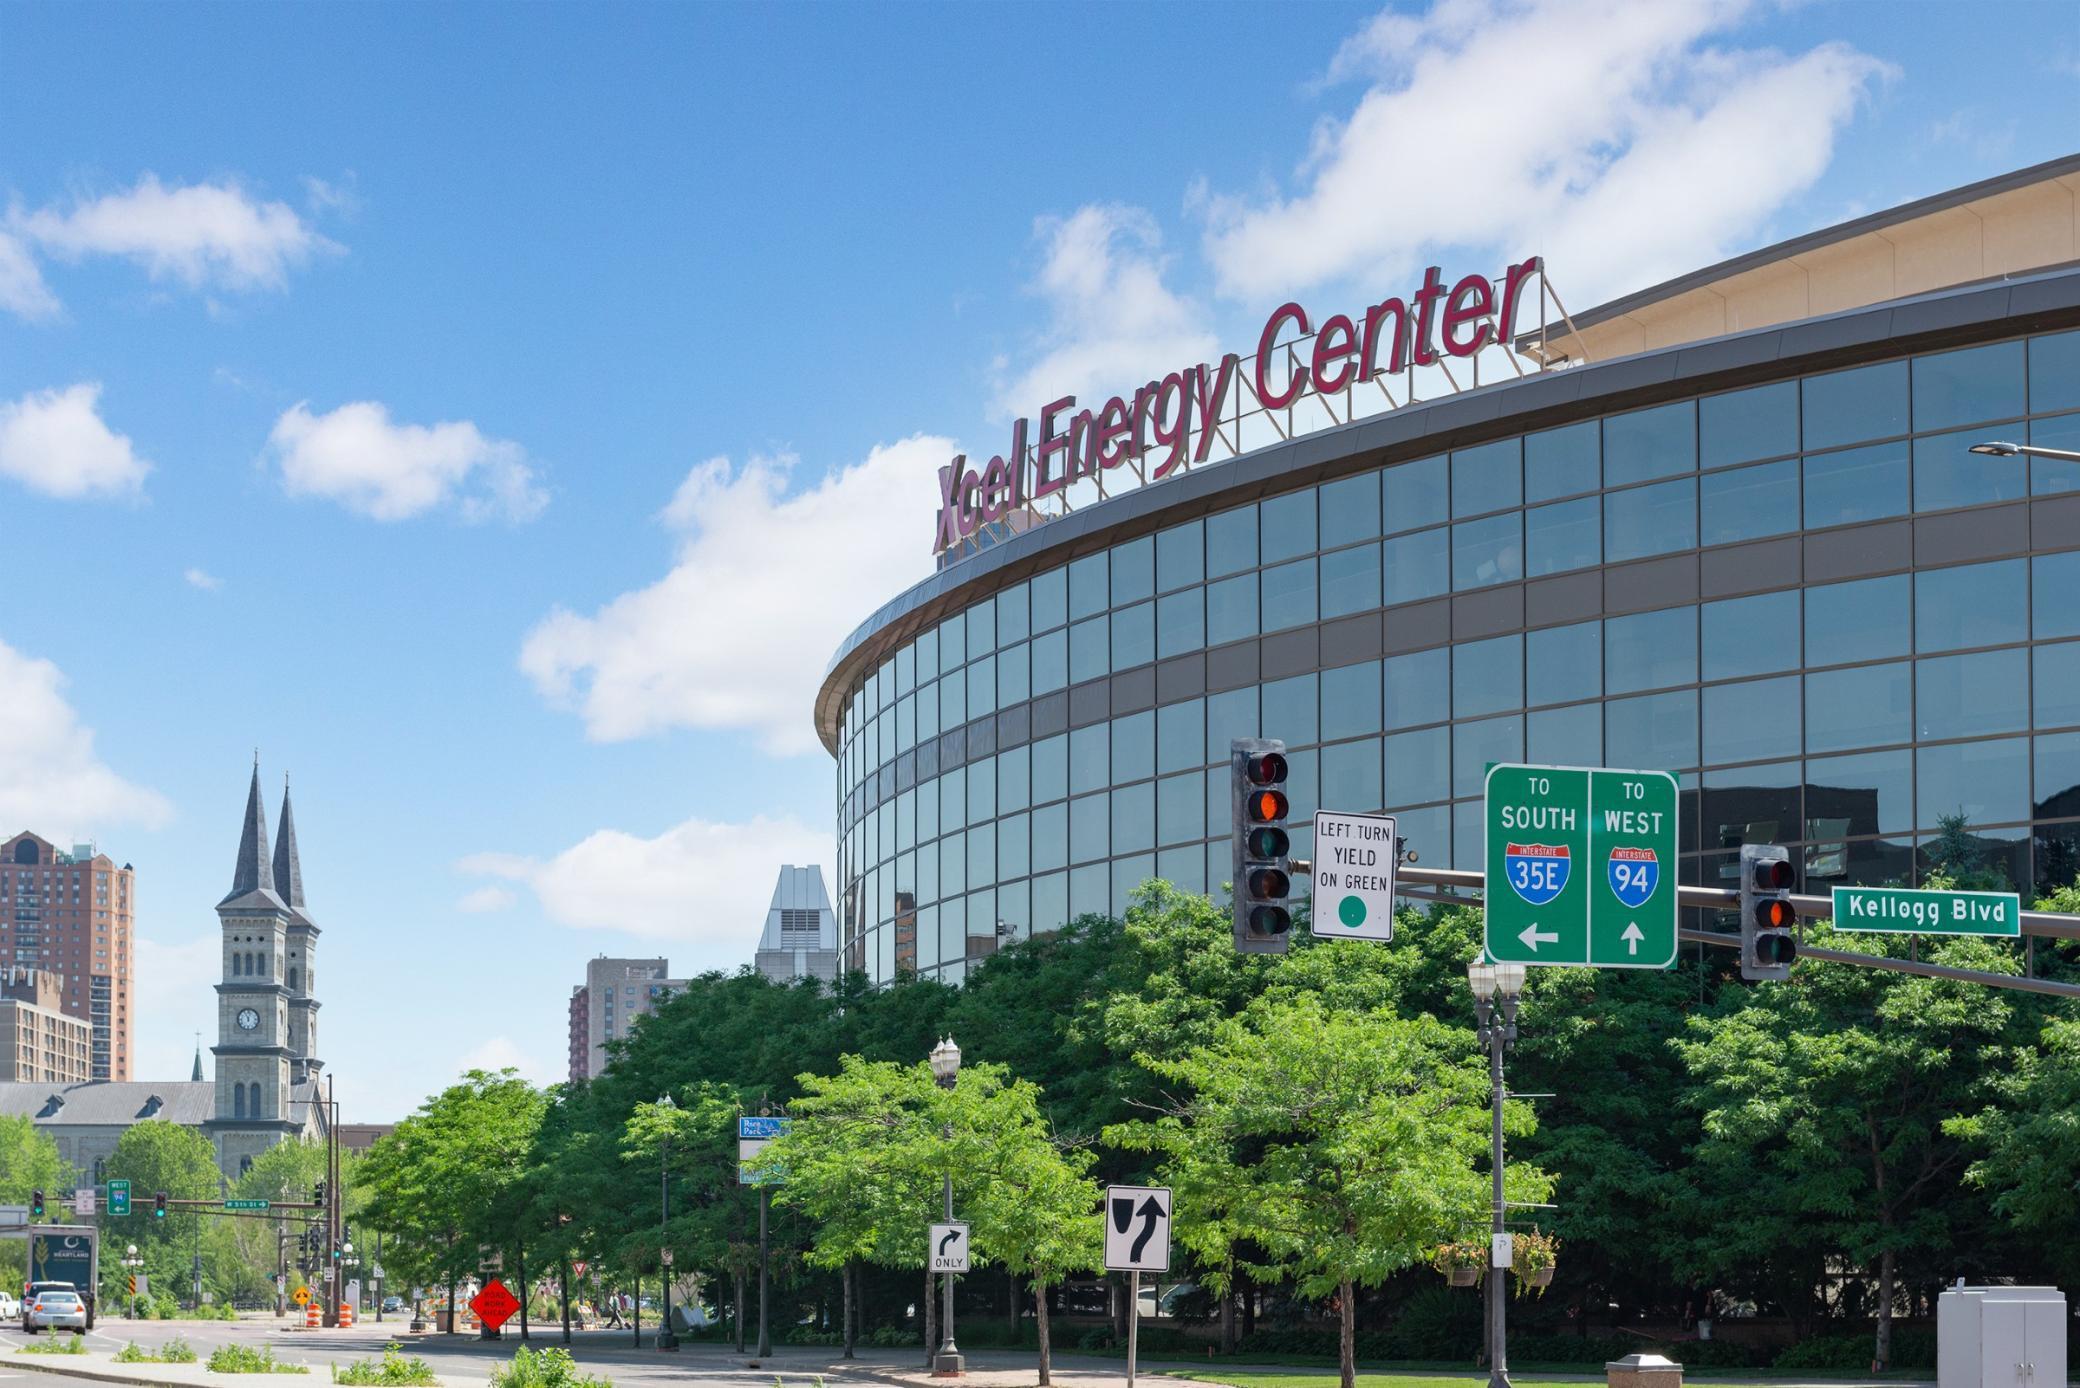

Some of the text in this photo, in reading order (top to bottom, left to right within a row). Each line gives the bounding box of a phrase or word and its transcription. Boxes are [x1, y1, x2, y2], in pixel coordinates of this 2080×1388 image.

[934, 256, 1543, 556] Xcel Energy Center
[1528, 777, 1550, 796] TO
[1622, 782, 1645, 800] TO
[1501, 805, 1576, 831] SOUTH
[1604, 809, 1663, 835] WEST
[1320, 821, 1390, 842] LEFT TURN
[1334, 846, 1376, 867] YIELD
[1519, 847, 1557, 857] INTERSTATE
[1615, 851, 1652, 861] INTERSTATE
[1320, 871, 1388, 892] ON GREEN
[1515, 861, 1559, 890] 35E
[1615, 864, 1649, 893] 94
[1849, 894, 2006, 927] Kellogg Blvd
[935, 1257, 963, 1268] ONLY
